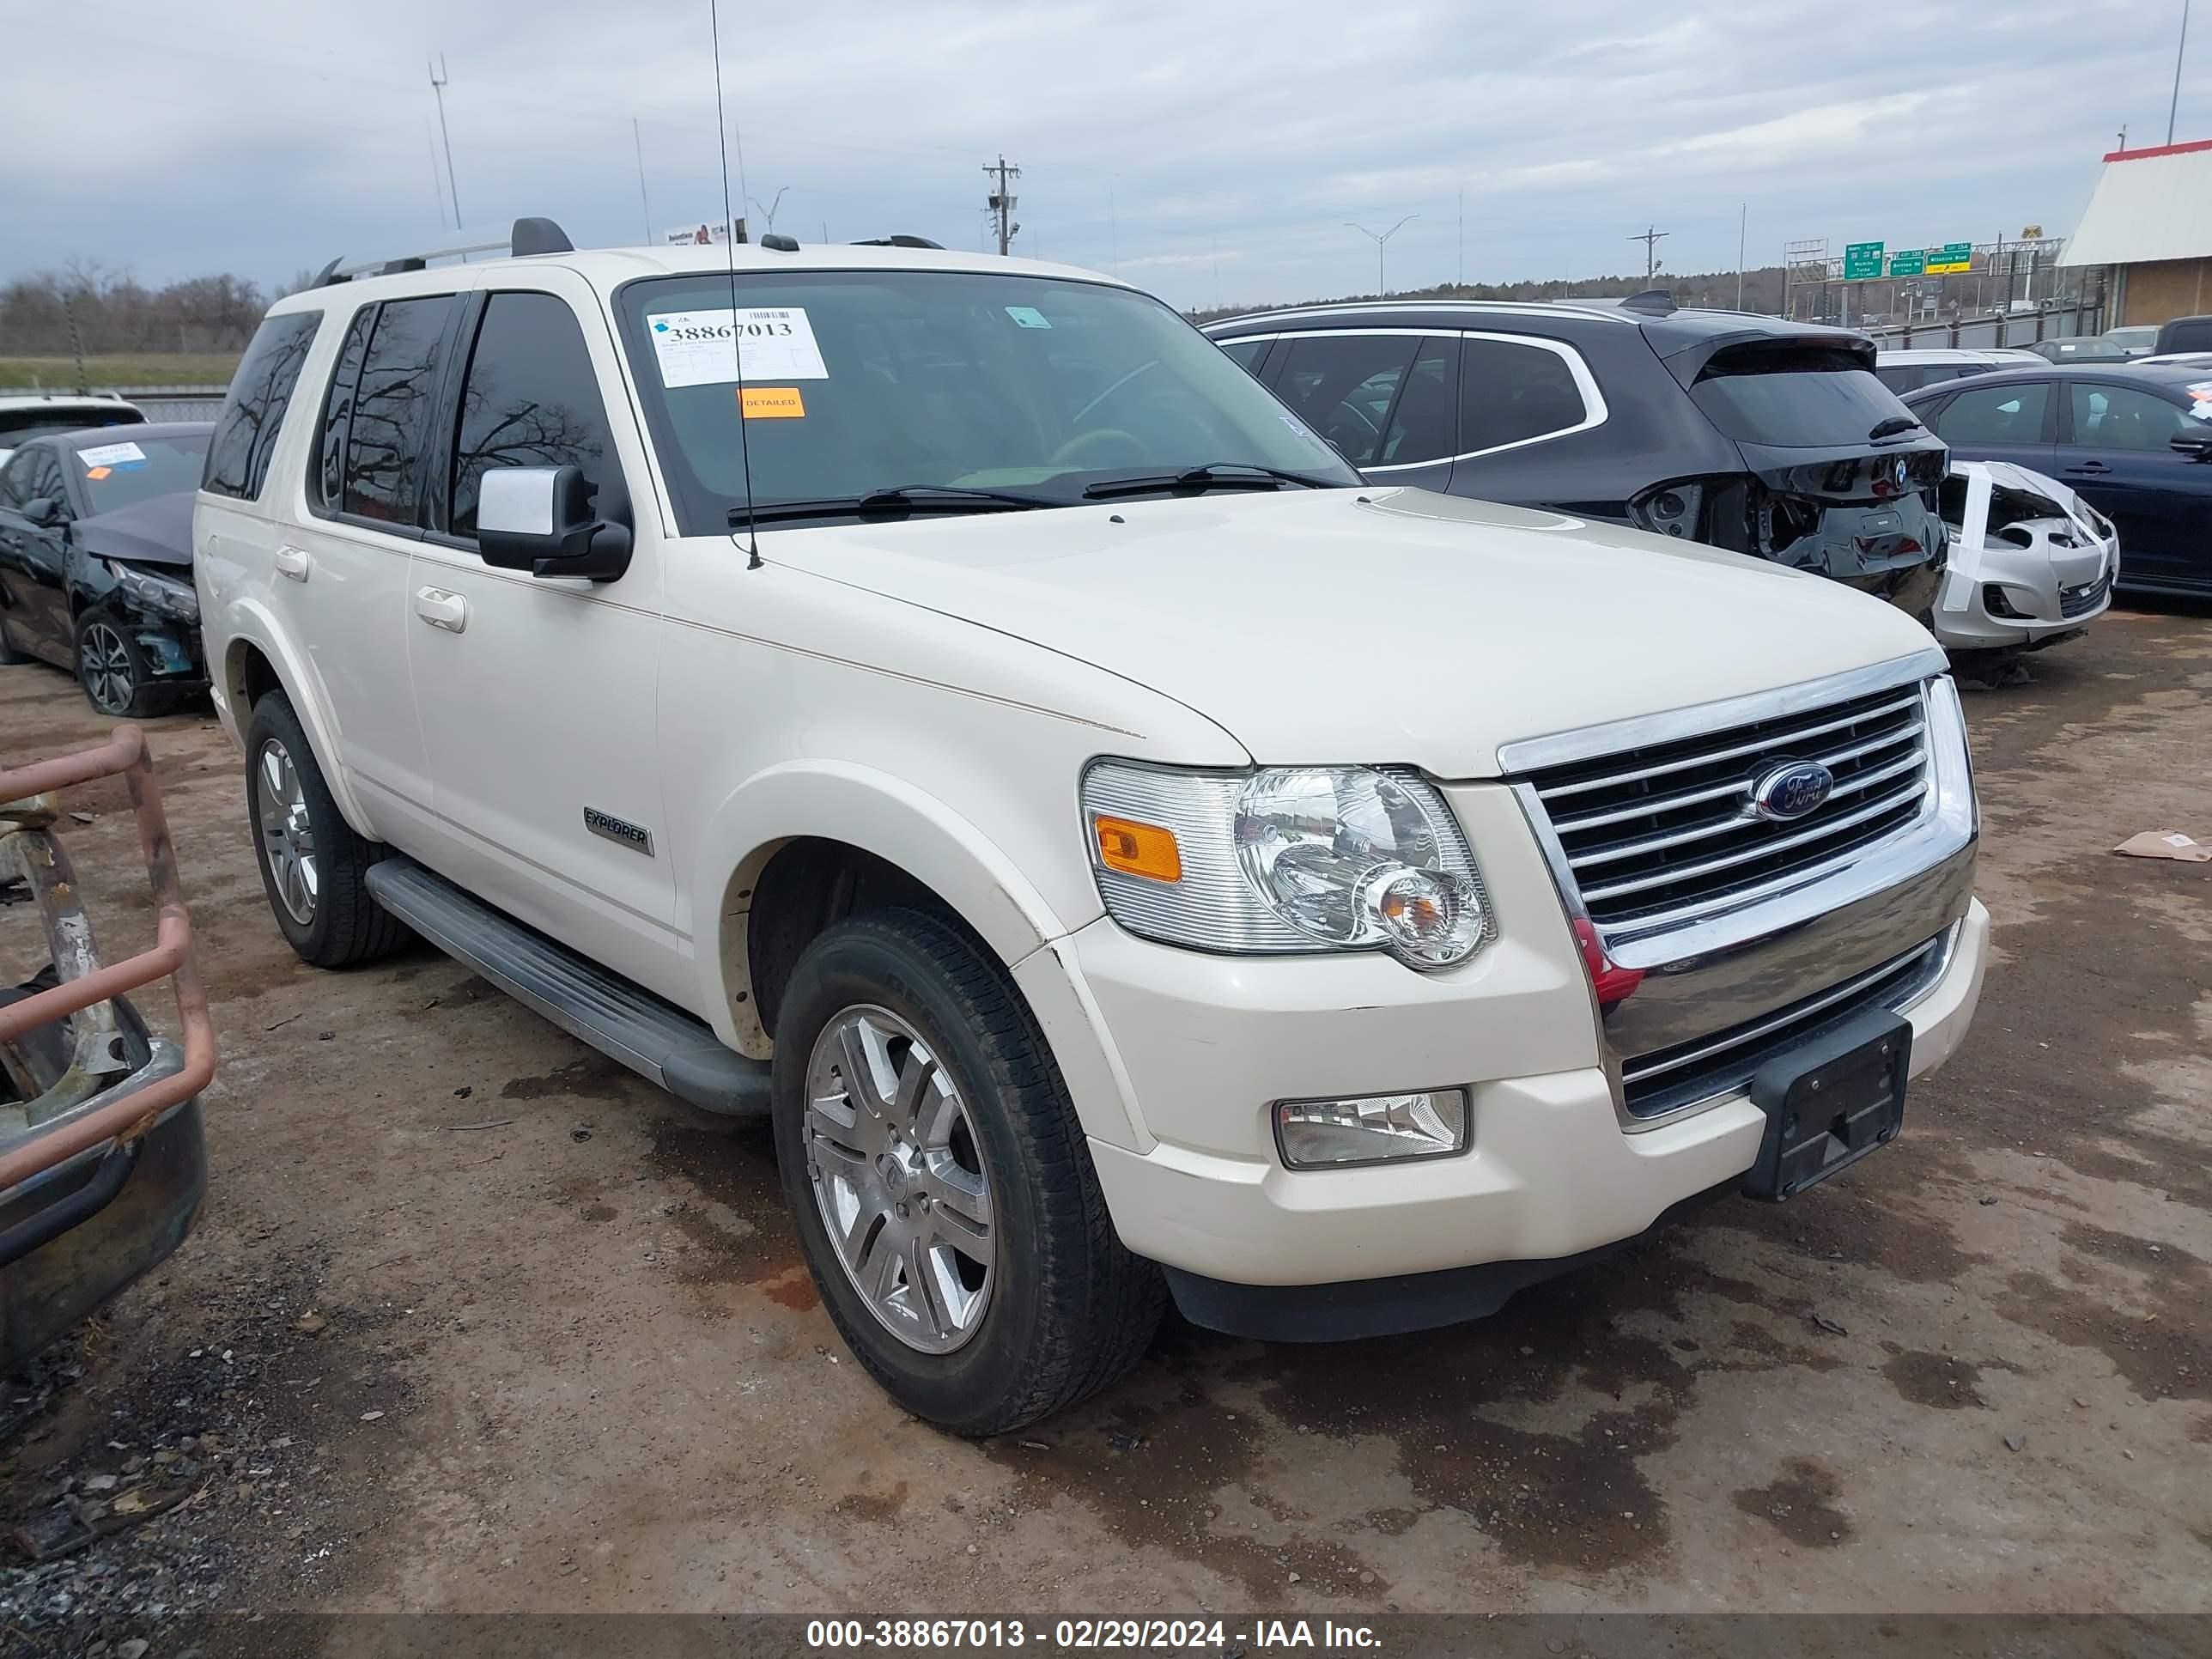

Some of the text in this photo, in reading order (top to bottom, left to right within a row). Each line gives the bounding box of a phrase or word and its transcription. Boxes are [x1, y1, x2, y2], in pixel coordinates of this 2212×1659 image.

[670, 323, 792, 343] 38867013
[746, 398, 796, 407] DETAILED
[1784, 771, 1823, 809] Ford
[585, 809, 647, 844] EXPLORER
